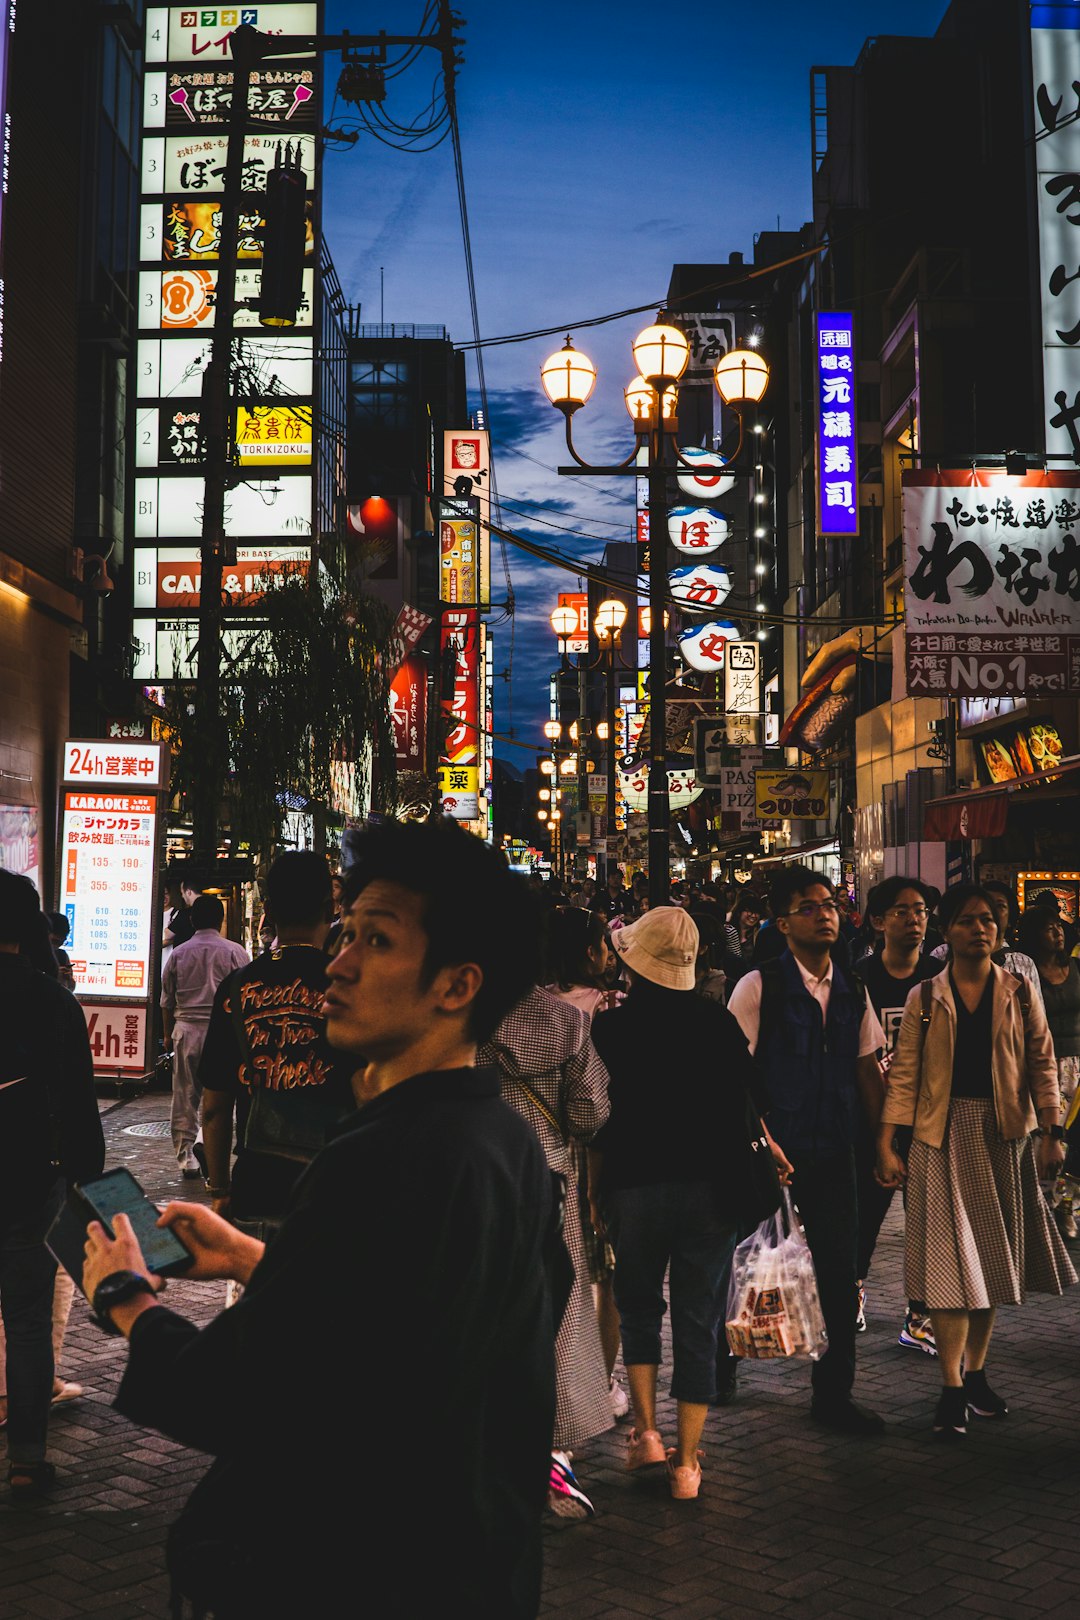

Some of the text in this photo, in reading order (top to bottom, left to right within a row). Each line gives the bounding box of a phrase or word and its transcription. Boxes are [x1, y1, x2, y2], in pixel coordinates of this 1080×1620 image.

[182, 11, 257, 27] カラオケ
[151, 29, 160, 42] 4
[149, 93, 158, 106] 3
[148, 159, 156, 172] 3
[146, 226, 155, 239] 3
[145, 294, 153, 307] 3
[822, 333, 849, 346] 元祖
[143, 362, 152, 375] 3
[142, 431, 151, 445] 2
[244, 445, 303, 454] TORIKIZOKU
[139, 501, 152, 515] B1
[946, 496, 1080, 532] たこ焼道楽
[252, 550, 273, 558] BASE
[138, 571, 152, 585] B1
[223, 573, 243, 594] &
[164, 622, 187, 631] LIVE
[138, 642, 152, 656] B1
[910, 635, 1060, 652] 千日前で愛されて半世紀
[733, 650, 753, 665] 牛角
[910, 655, 947, 669] 大阪で
[910, 670, 947, 689] 人気
[950, 655, 1026, 690] No.1
[733, 673, 753, 745] 焼肉酒家
[69, 748, 154, 777] 24h営業中
[450, 770, 469, 789] 薬
[69, 796, 129, 811] KARAOKE
[84, 817, 142, 831] ジャンカラ
[68, 831, 114, 845] 飲み放題
[92, 857, 139, 868] 135 190
[90, 880, 138, 892] 355 395
[95, 907, 109, 915] 610
[124, 1015, 139, 1059] 営業中
